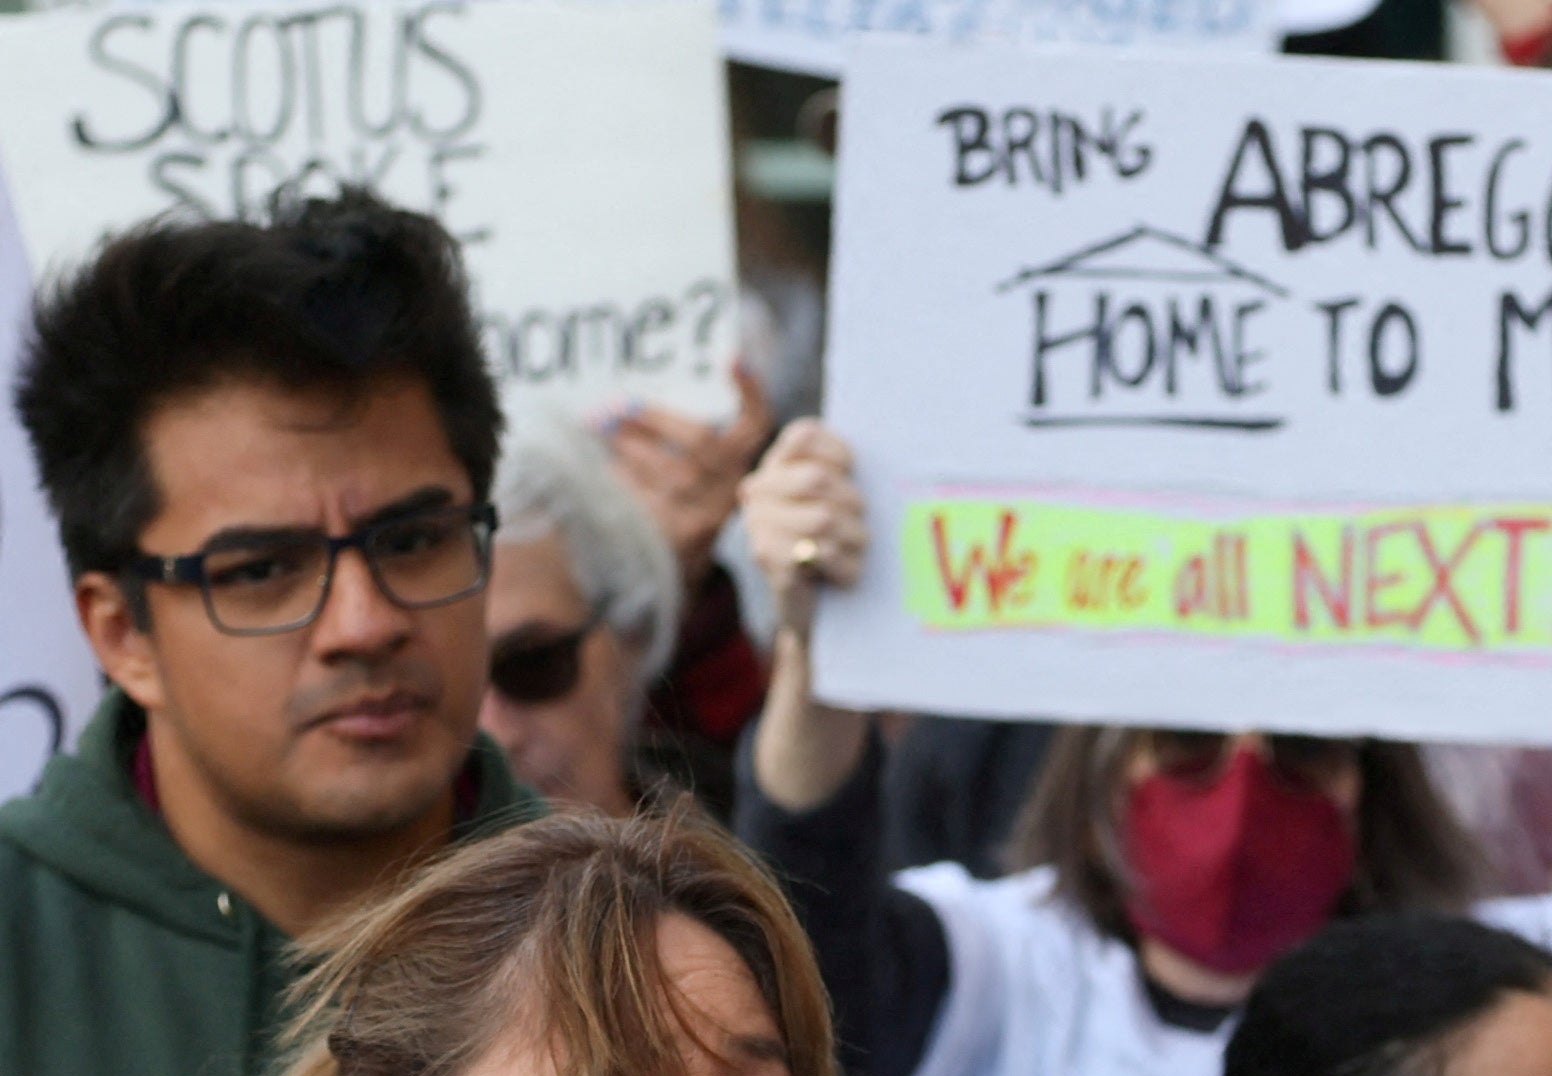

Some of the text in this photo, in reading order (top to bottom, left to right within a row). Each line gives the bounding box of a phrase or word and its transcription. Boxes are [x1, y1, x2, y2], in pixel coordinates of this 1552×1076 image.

[71, 3, 481, 151] SCOTUS
[936, 106, 1153, 194] BRING
[1029, 290, 1269, 405] HOME
[1317, 297, 1419, 397] TO
[931, 508, 1037, 612] We
[1064, 549, 1150, 611] are
[1174, 531, 1250, 618] all
